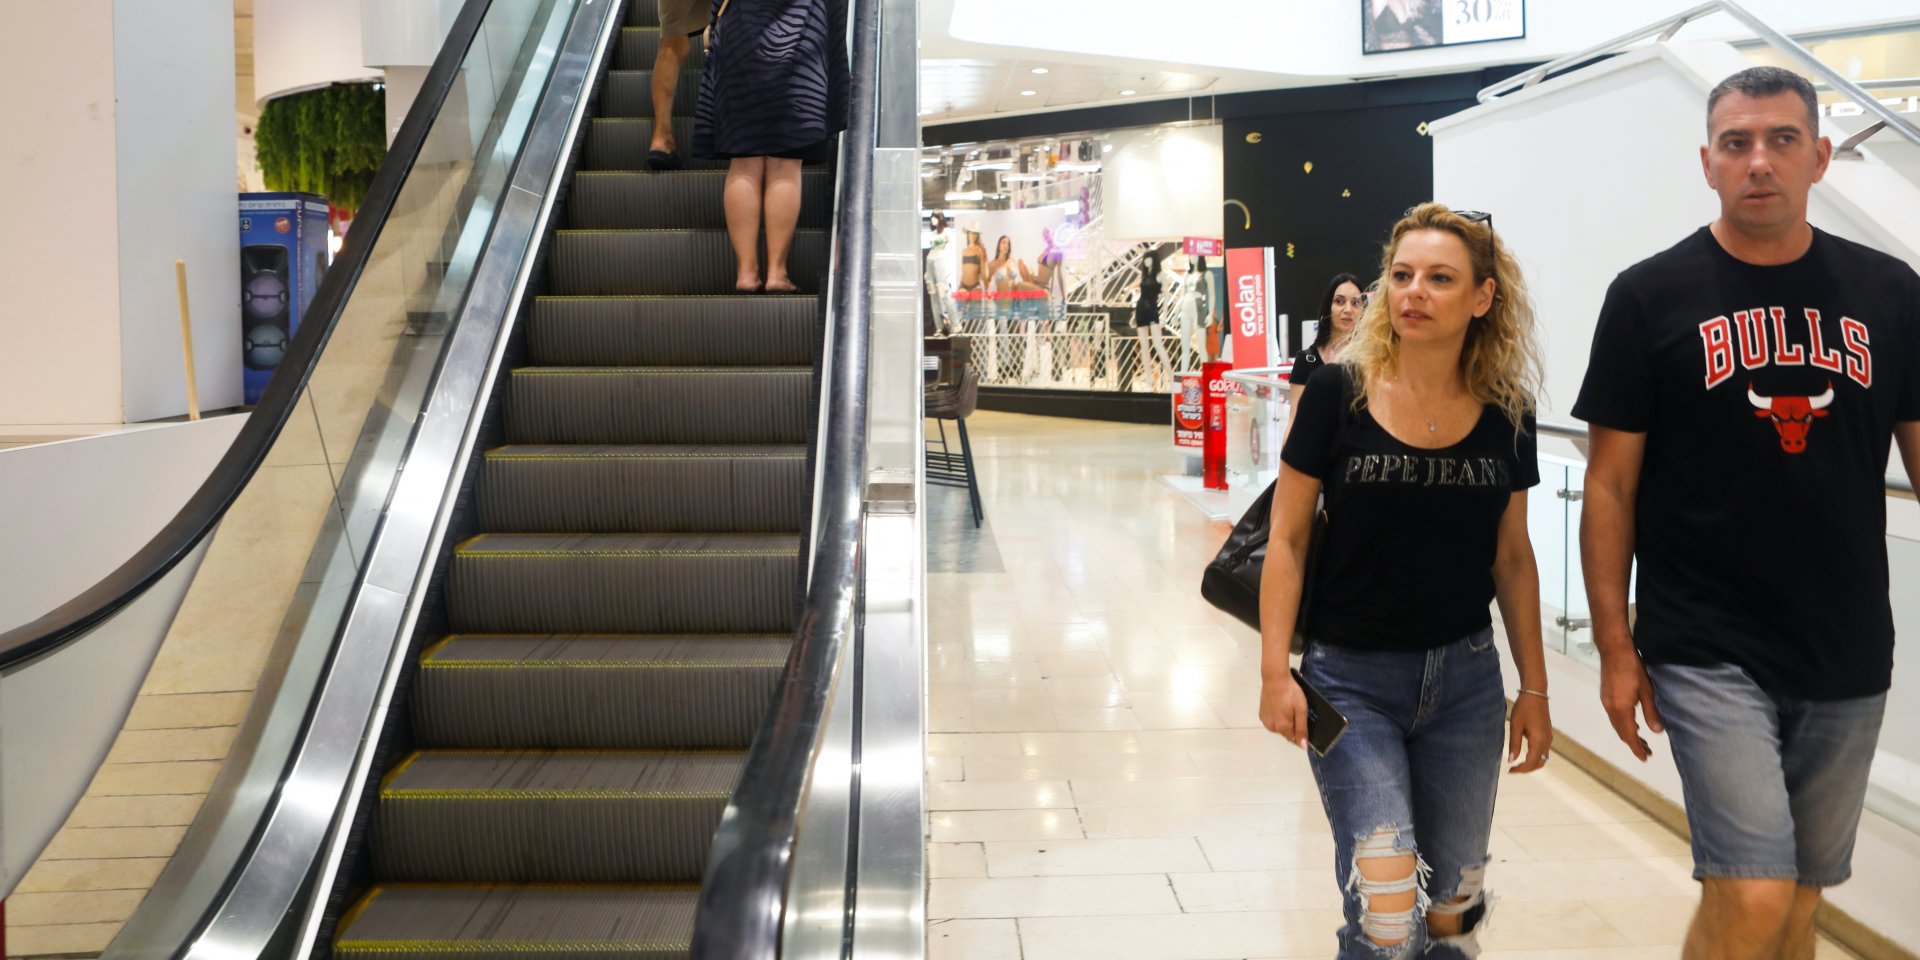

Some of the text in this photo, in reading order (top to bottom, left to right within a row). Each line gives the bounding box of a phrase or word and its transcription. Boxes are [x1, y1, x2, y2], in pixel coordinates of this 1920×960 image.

[1455, 0, 1492, 24] 30
[1234, 274, 1257, 337] Golan
[1699, 306, 1872, 390] BULLS
[1344, 454, 1511, 486] PEPE JEANS
